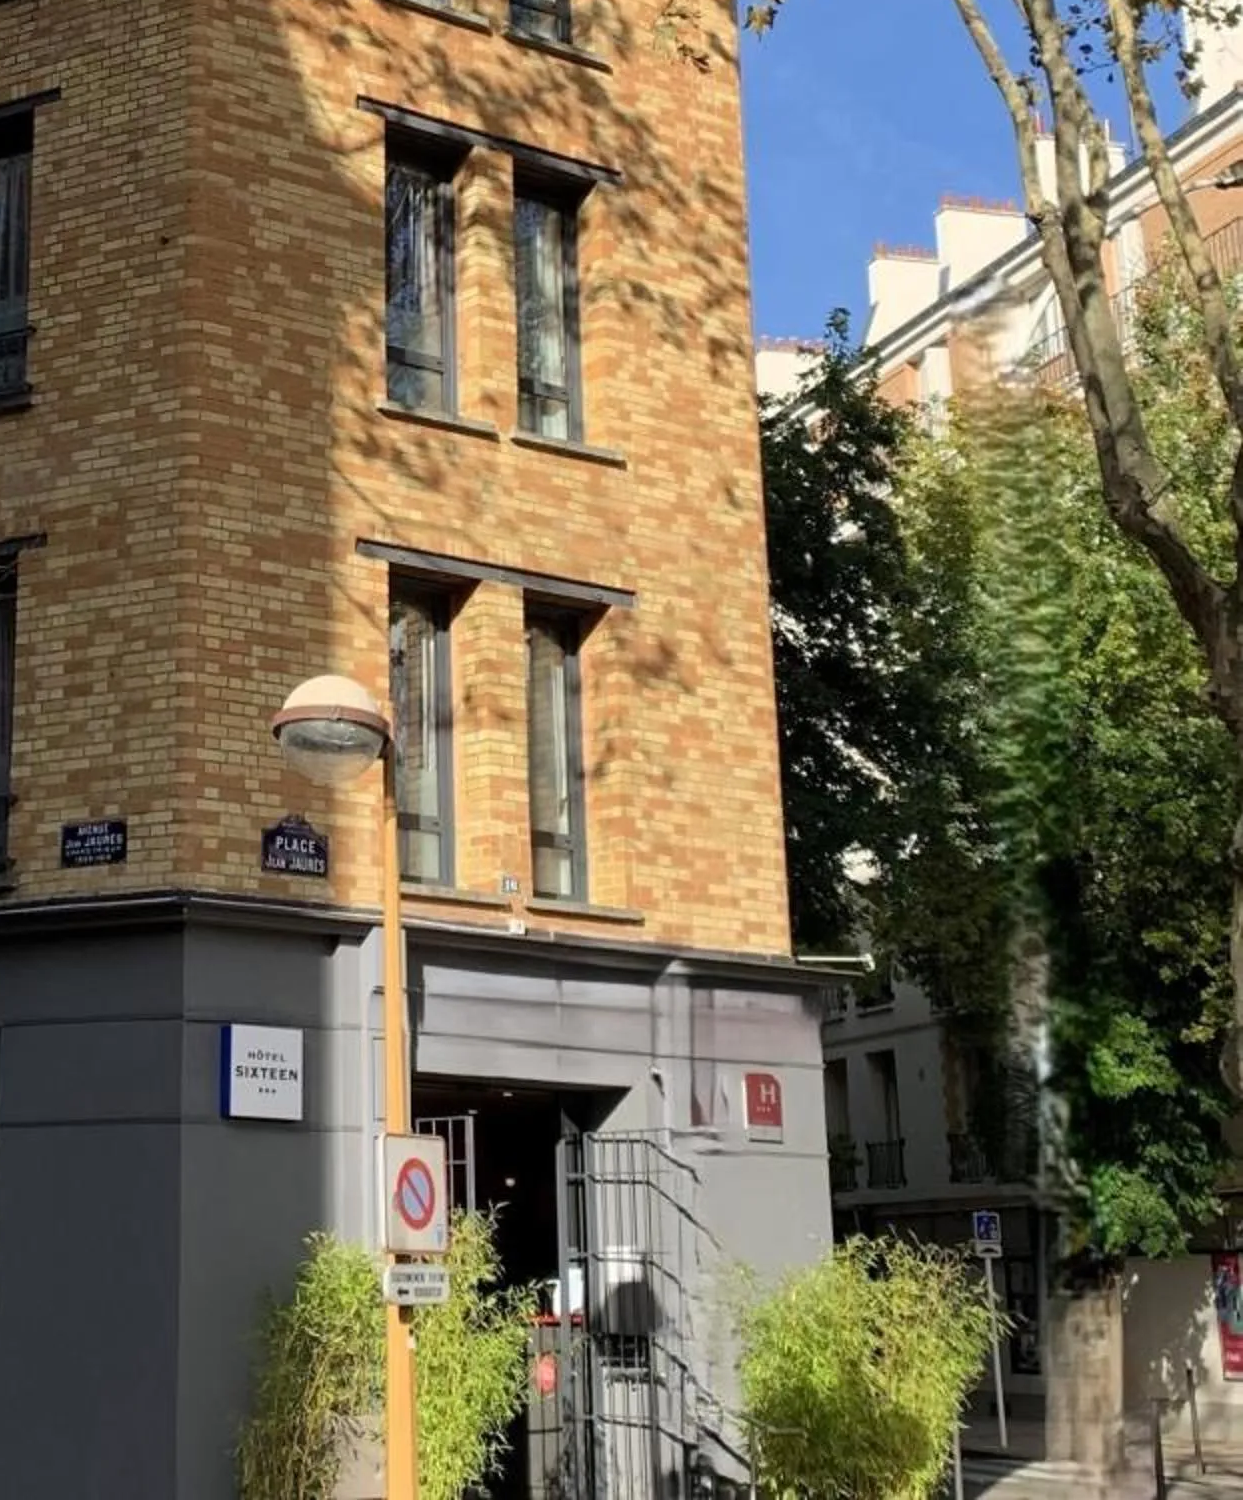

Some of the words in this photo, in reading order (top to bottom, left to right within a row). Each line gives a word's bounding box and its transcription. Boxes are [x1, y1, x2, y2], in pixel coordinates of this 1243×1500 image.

[276, 836, 316, 854] PLACE
[247, 1049, 287, 1062] HÔTEL
[235, 1065, 298, 1082] SIXTEEN
[760, 1082, 776, 1104] H
